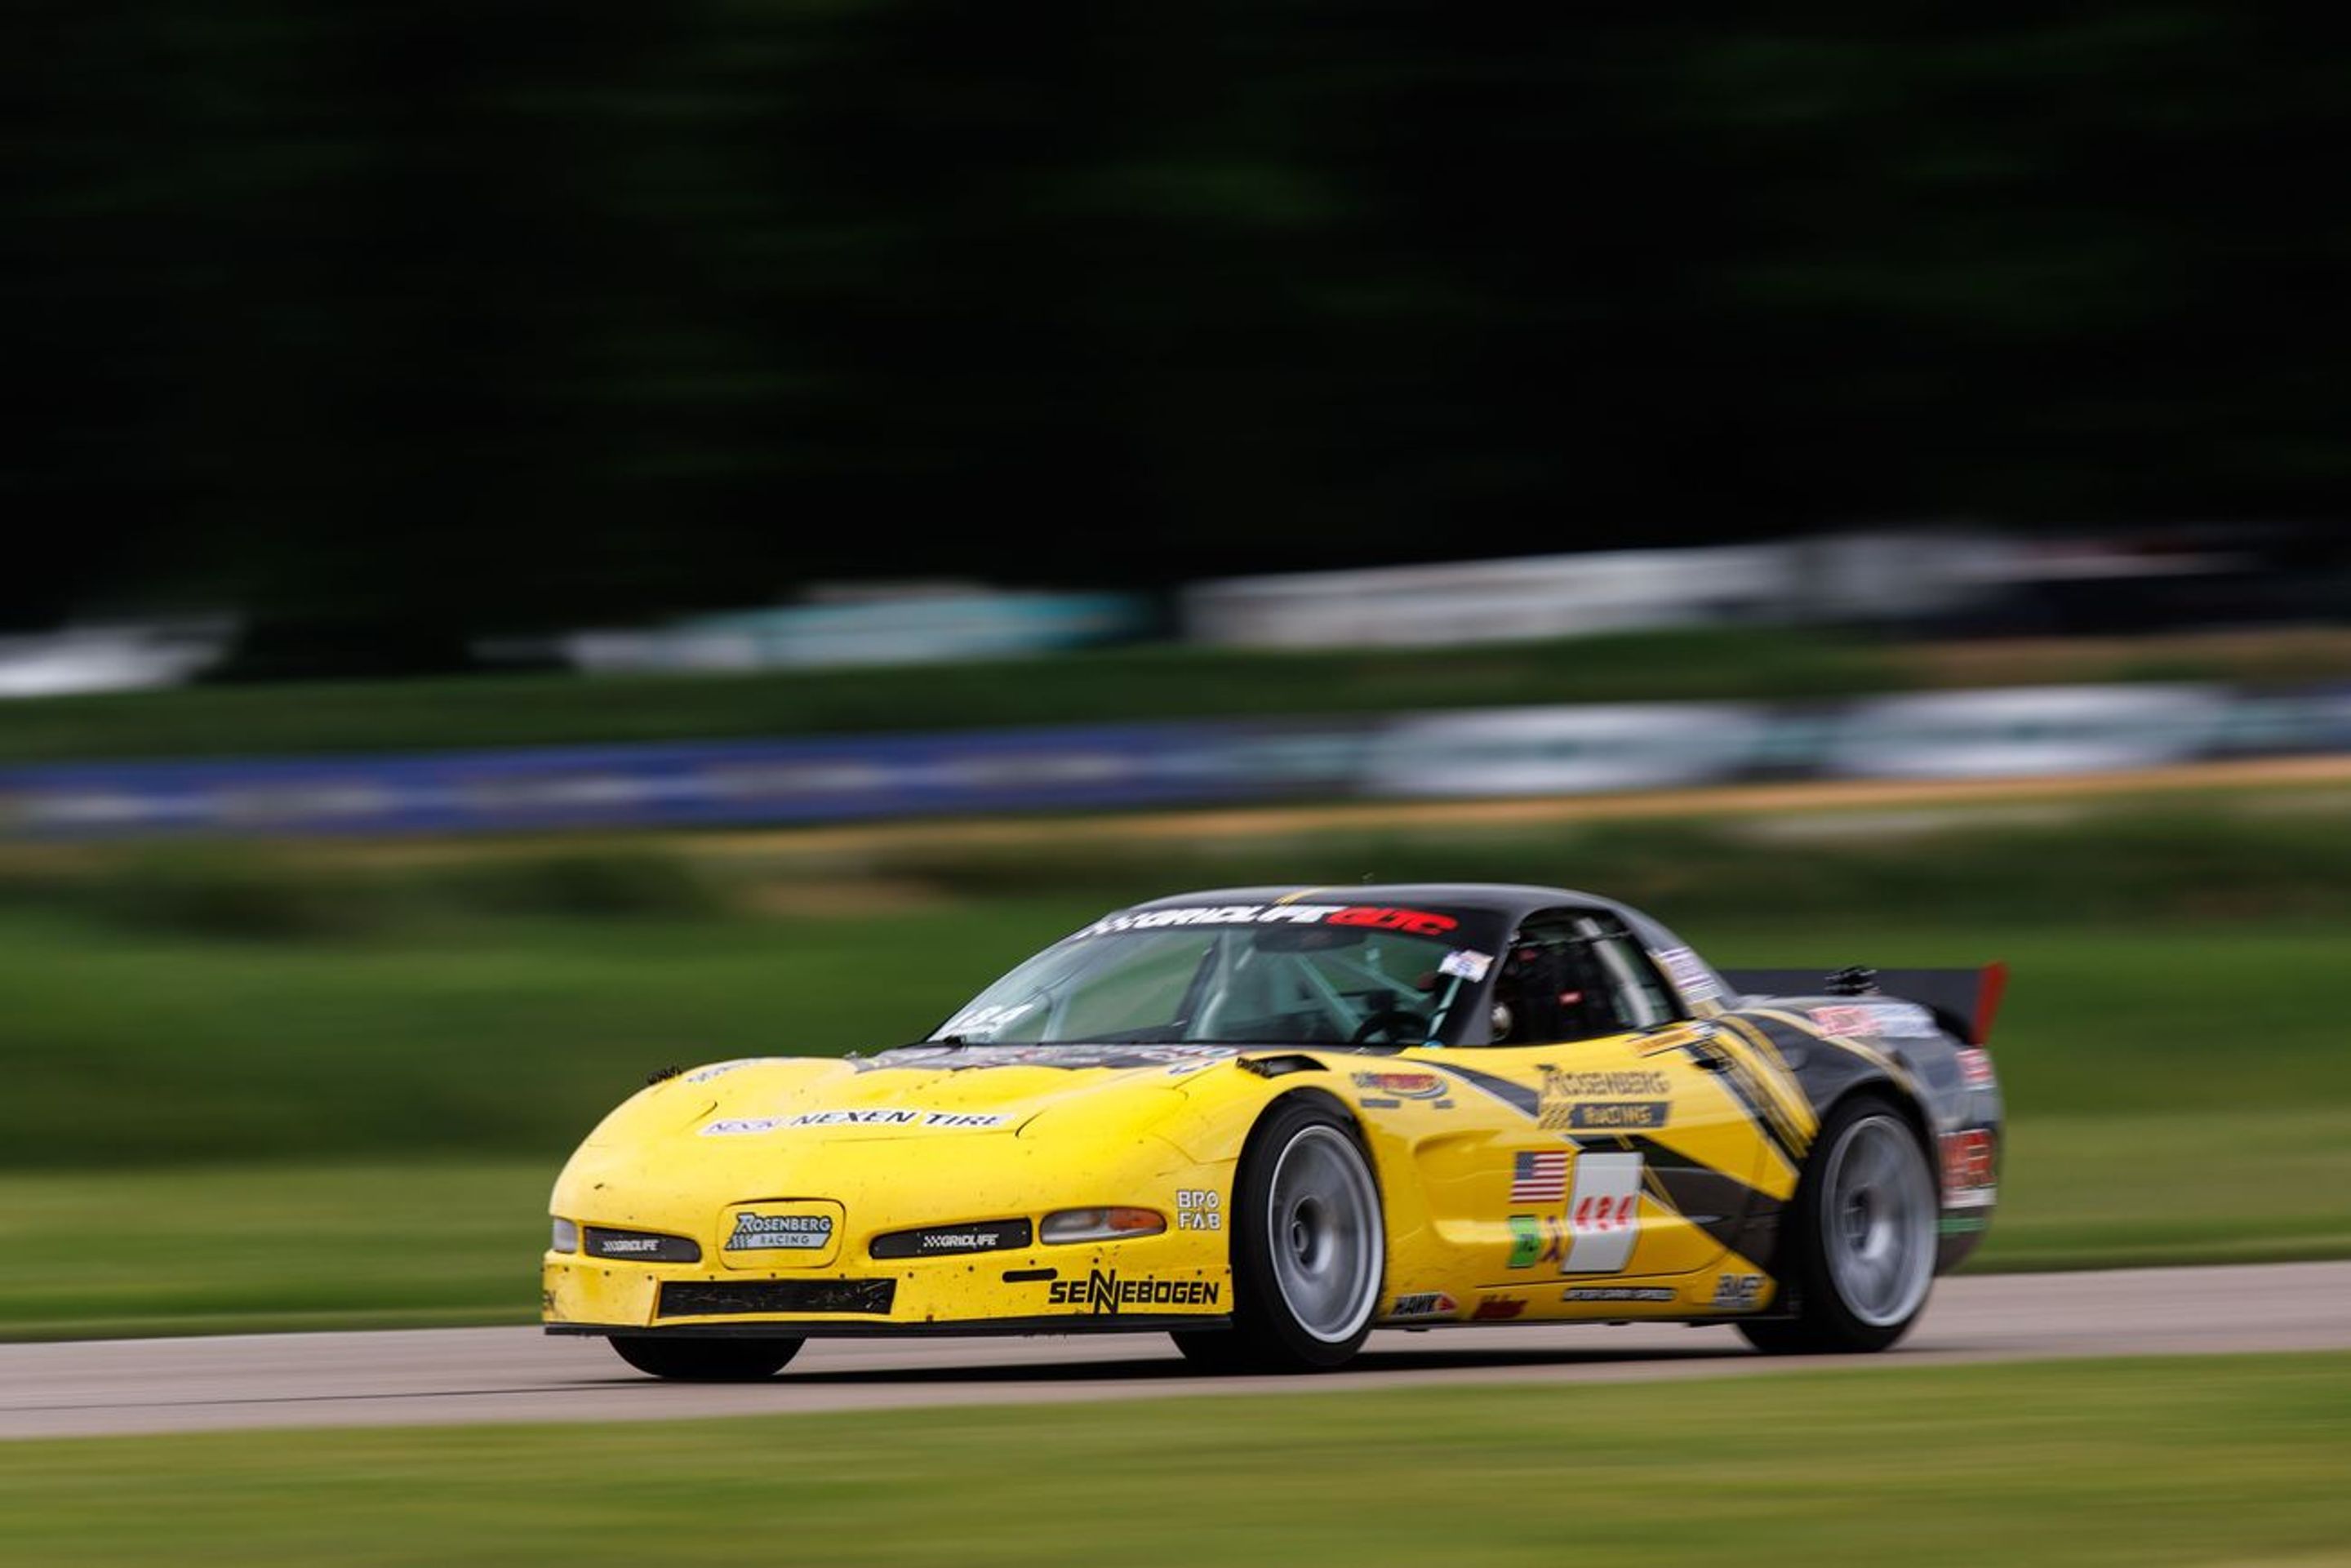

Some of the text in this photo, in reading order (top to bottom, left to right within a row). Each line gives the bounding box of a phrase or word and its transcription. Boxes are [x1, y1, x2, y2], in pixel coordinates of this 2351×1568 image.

[789, 1111, 917, 1126] NEXEN
[924, 1113, 1004, 1126] TIRE
[1176, 1190, 1219, 1208] BRO
[736, 1213, 832, 1233] ROSENBERG
[1178, 1211, 1221, 1230] FAB
[760, 1235, 810, 1245] RACING
[940, 1233, 1000, 1250] GRIDLIFE
